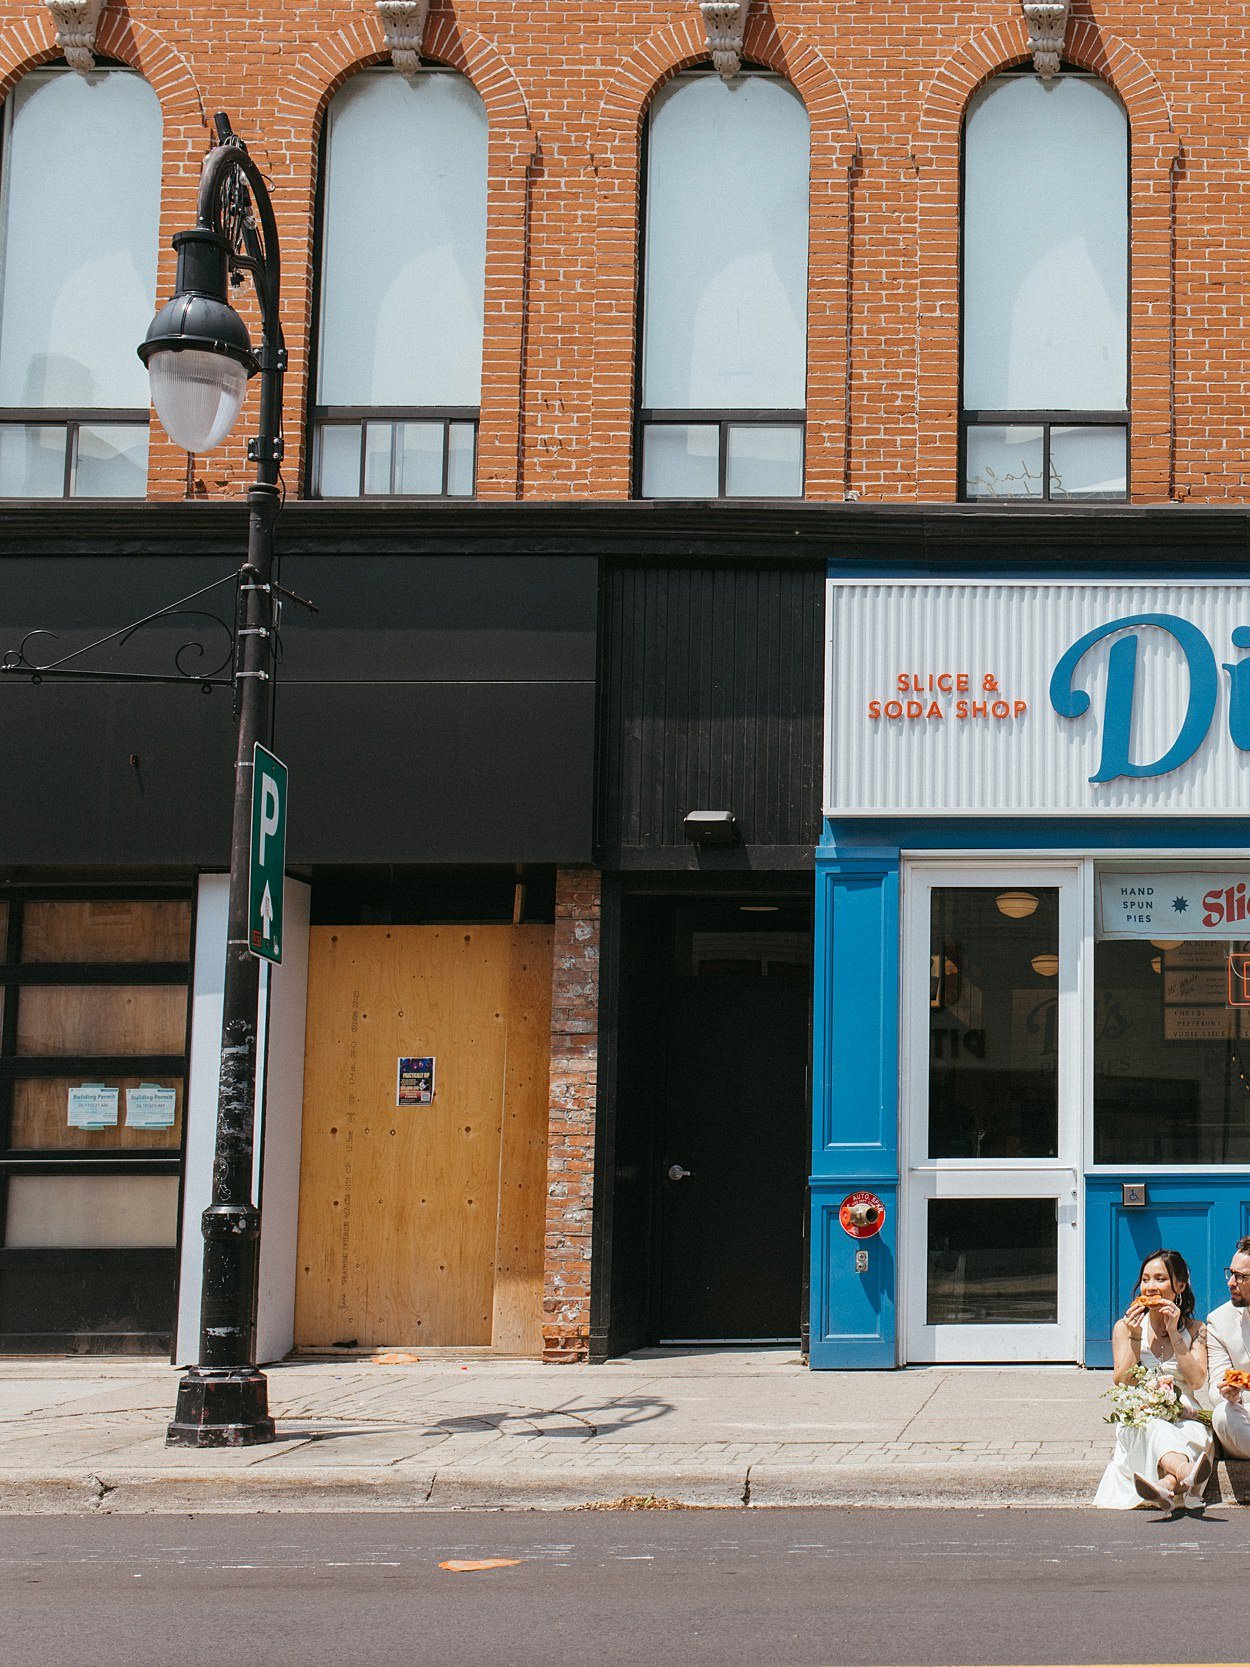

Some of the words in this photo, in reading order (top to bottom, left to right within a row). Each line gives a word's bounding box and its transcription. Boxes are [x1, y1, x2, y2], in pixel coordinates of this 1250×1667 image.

[897, 673, 970, 693] SLICE
[982, 673, 1000, 693] &
[868, 700, 944, 720] SODA
[956, 700, 1028, 720] SHOP
[258, 771, 280, 867] P
[1120, 887, 1155, 896] HAND
[1122, 901, 1154, 910] SPUN
[1126, 914, 1152, 923] PIES
